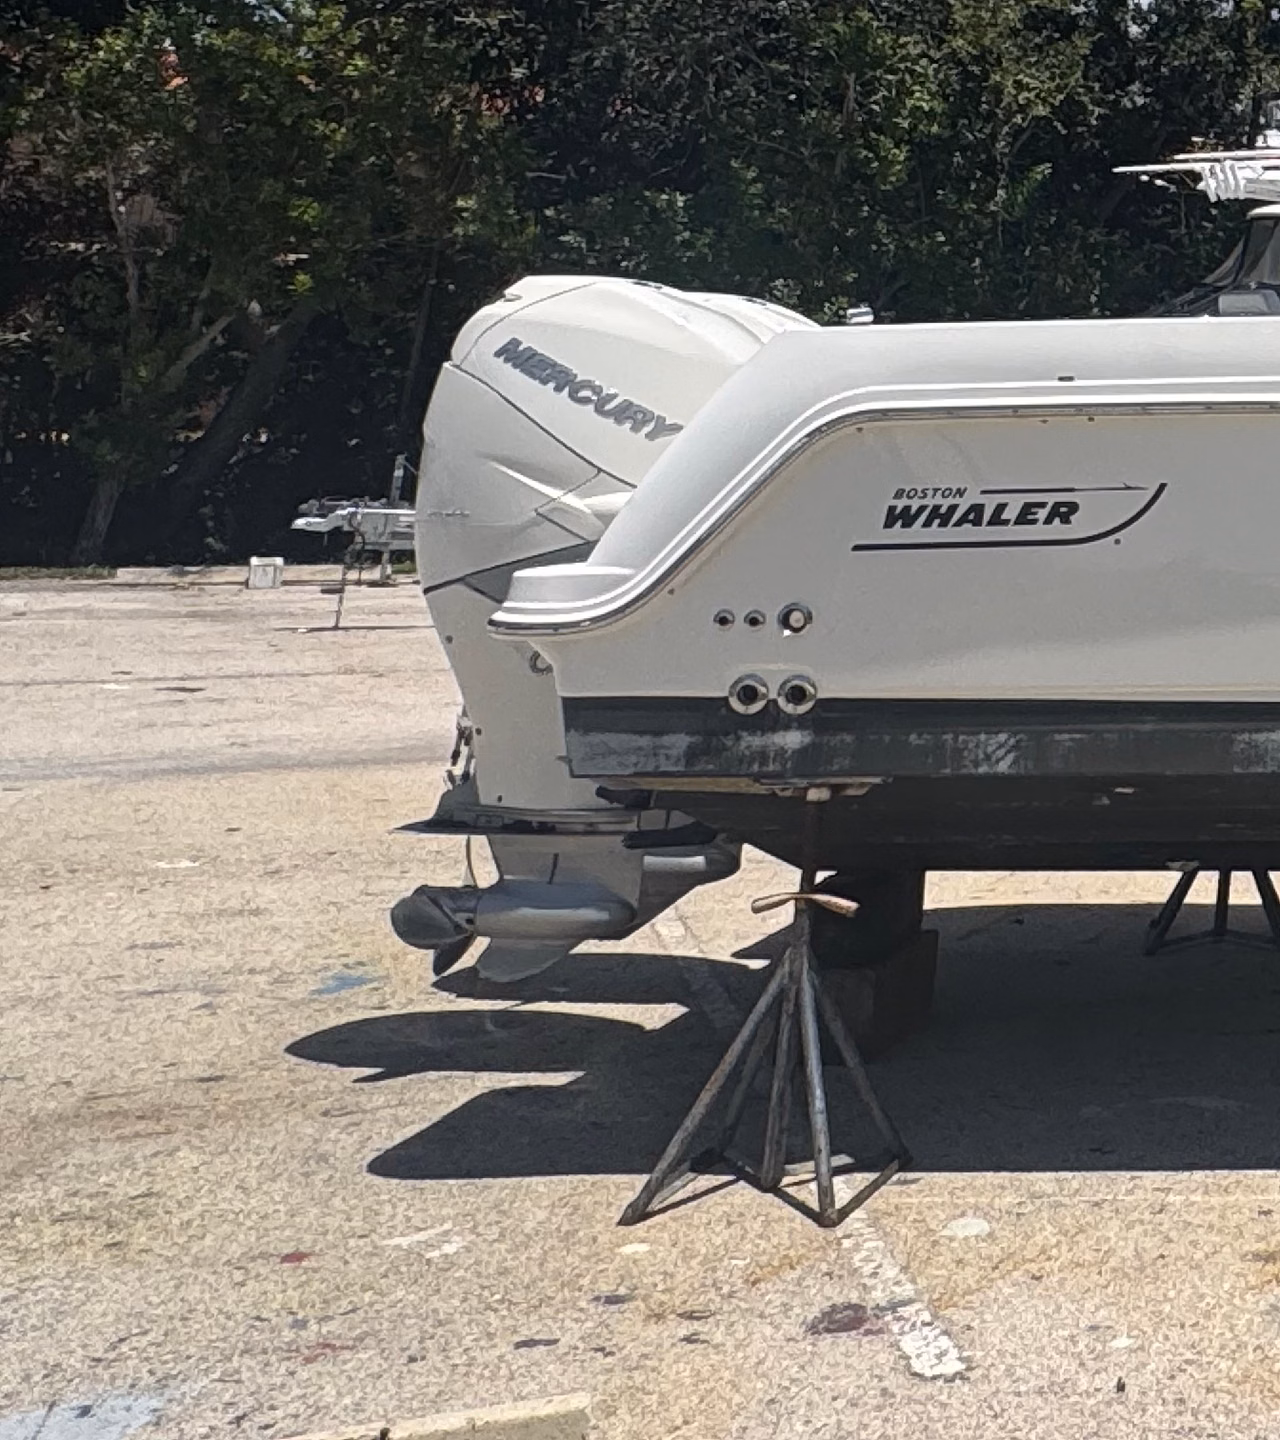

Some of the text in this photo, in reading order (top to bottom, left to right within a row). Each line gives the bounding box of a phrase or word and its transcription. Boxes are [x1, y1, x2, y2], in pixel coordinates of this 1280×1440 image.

[493, 337, 684, 442] MERCURY
[892, 486, 968, 500] BOSTON
[882, 501, 1080, 530] WHALER
